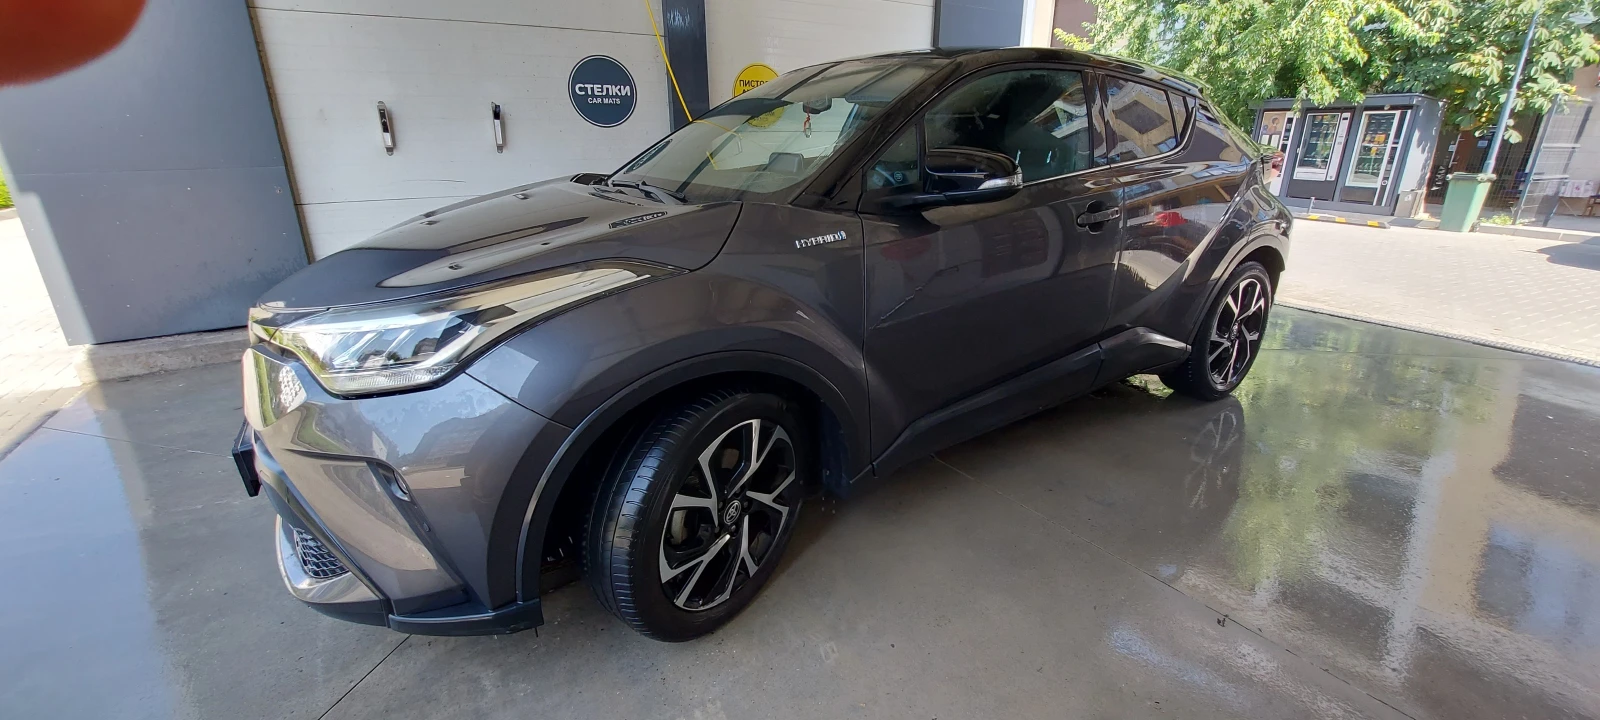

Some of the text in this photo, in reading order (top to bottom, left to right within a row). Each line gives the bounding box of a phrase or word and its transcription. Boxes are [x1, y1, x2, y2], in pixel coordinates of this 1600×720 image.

[575, 83, 631, 96] СТЕЛКИ
[739, 79, 769, 88] ПИСТО
[795, 232, 841, 249] HYBRID
